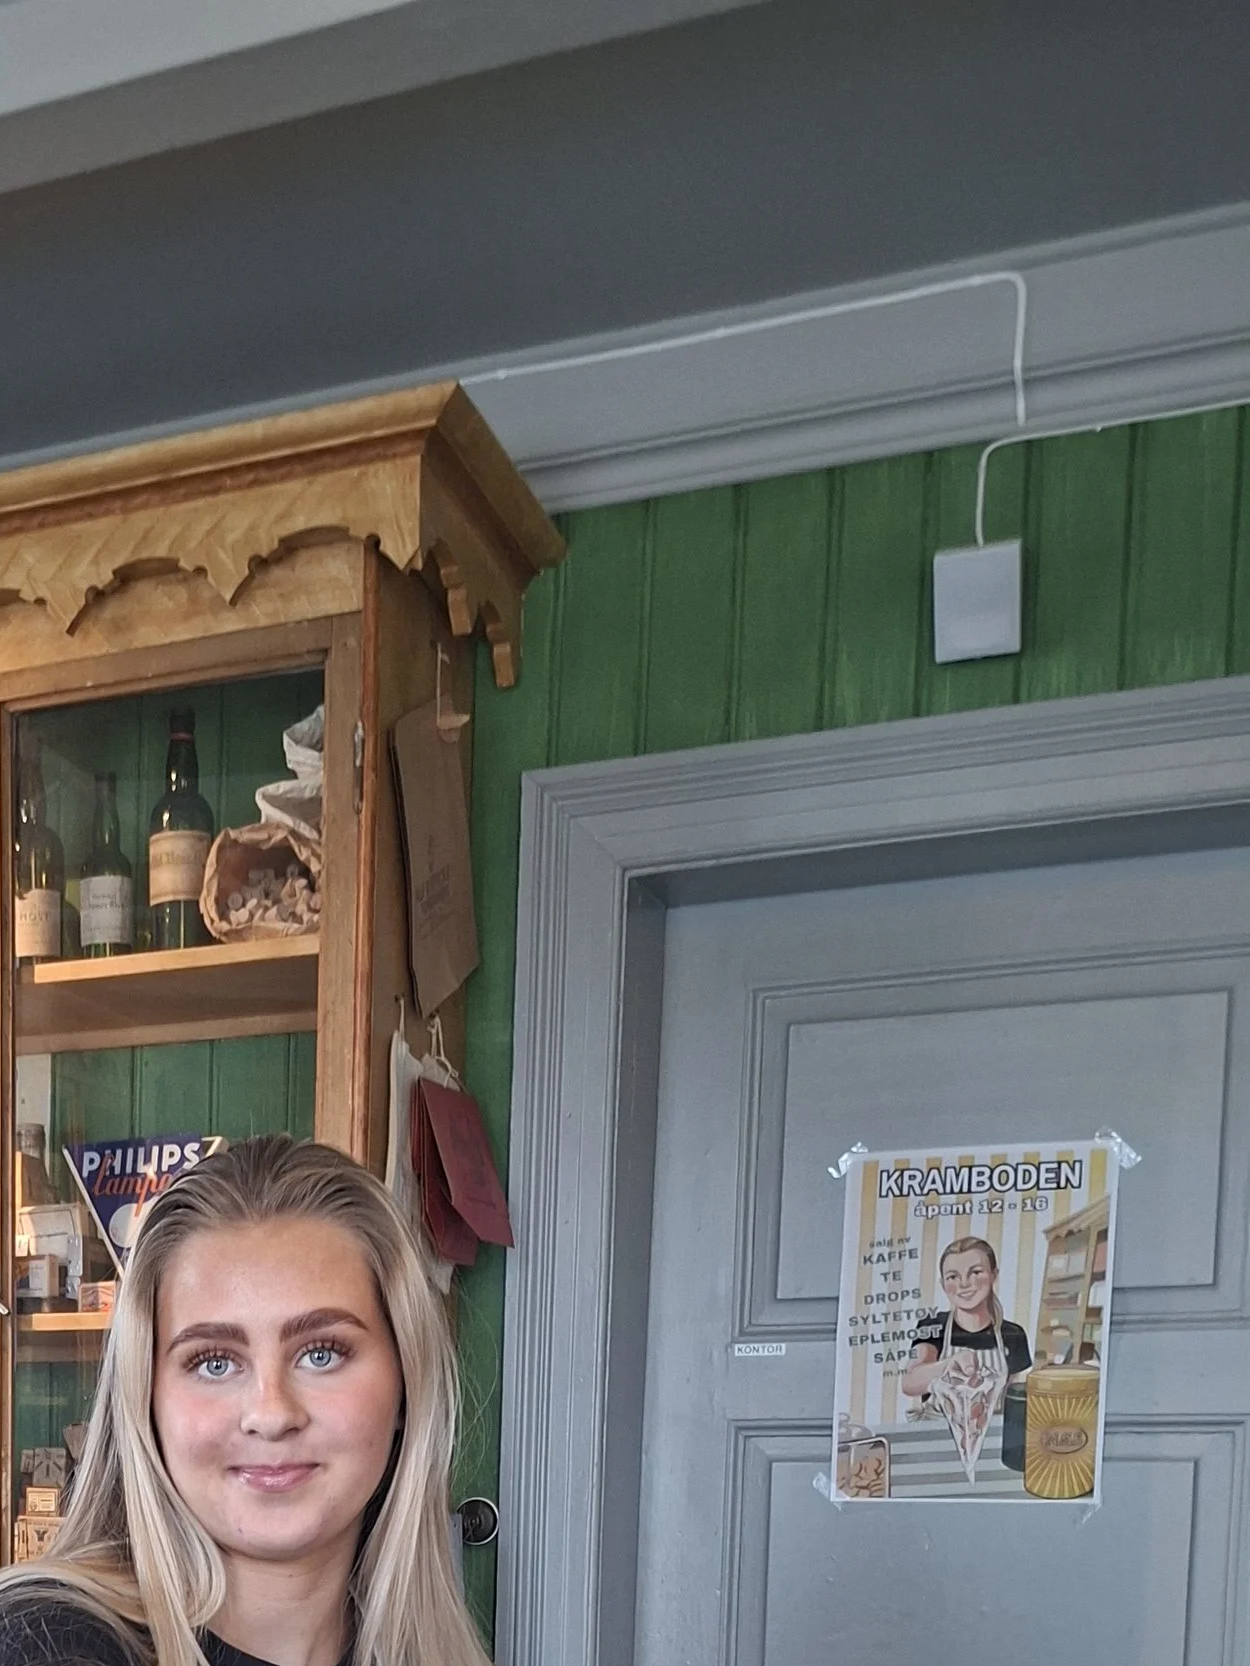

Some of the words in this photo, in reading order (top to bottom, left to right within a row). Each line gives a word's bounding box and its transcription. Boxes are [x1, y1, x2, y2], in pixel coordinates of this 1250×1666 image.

[81, 1143, 200, 1178] PHILIPS
[879, 1159, 1083, 1198] KRAMBODEN
[914, 1200, 974, 1220] åpent
[978, 1198, 1003, 1214] 12
[1021, 1196, 1048, 1212] 16
[863, 1248, 919, 1266] KAFFE
[880, 1271, 902, 1283] TE
[863, 1288, 922, 1305] DROPS
[848, 1305, 939, 1327] SYLTETØY
[848, 1324, 943, 1348] EPLEMOST
[736, 1344, 783, 1354] KONTOR
[873, 1348, 919, 1364] SÅPE
